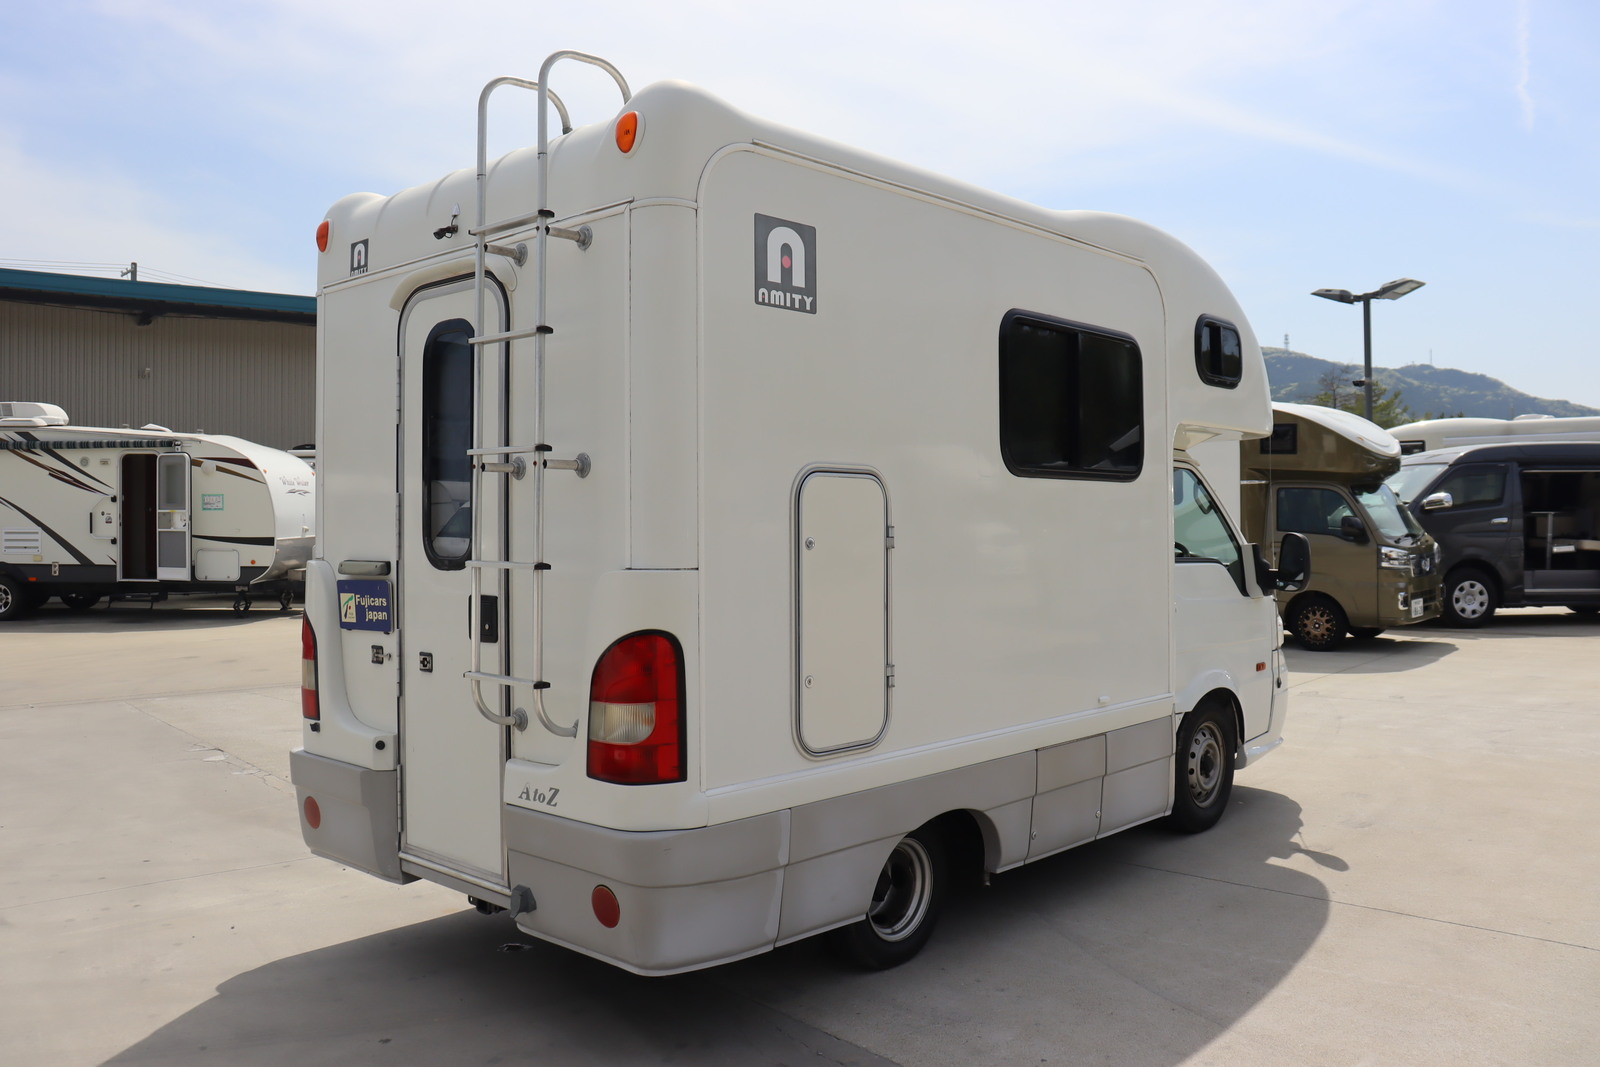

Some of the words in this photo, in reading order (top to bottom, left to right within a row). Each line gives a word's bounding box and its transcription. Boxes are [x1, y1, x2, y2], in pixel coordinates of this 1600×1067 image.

[758, 287, 814, 311] AMITY
[355, 594, 387, 608] Fujicars
[365, 608, 388, 622] japan
